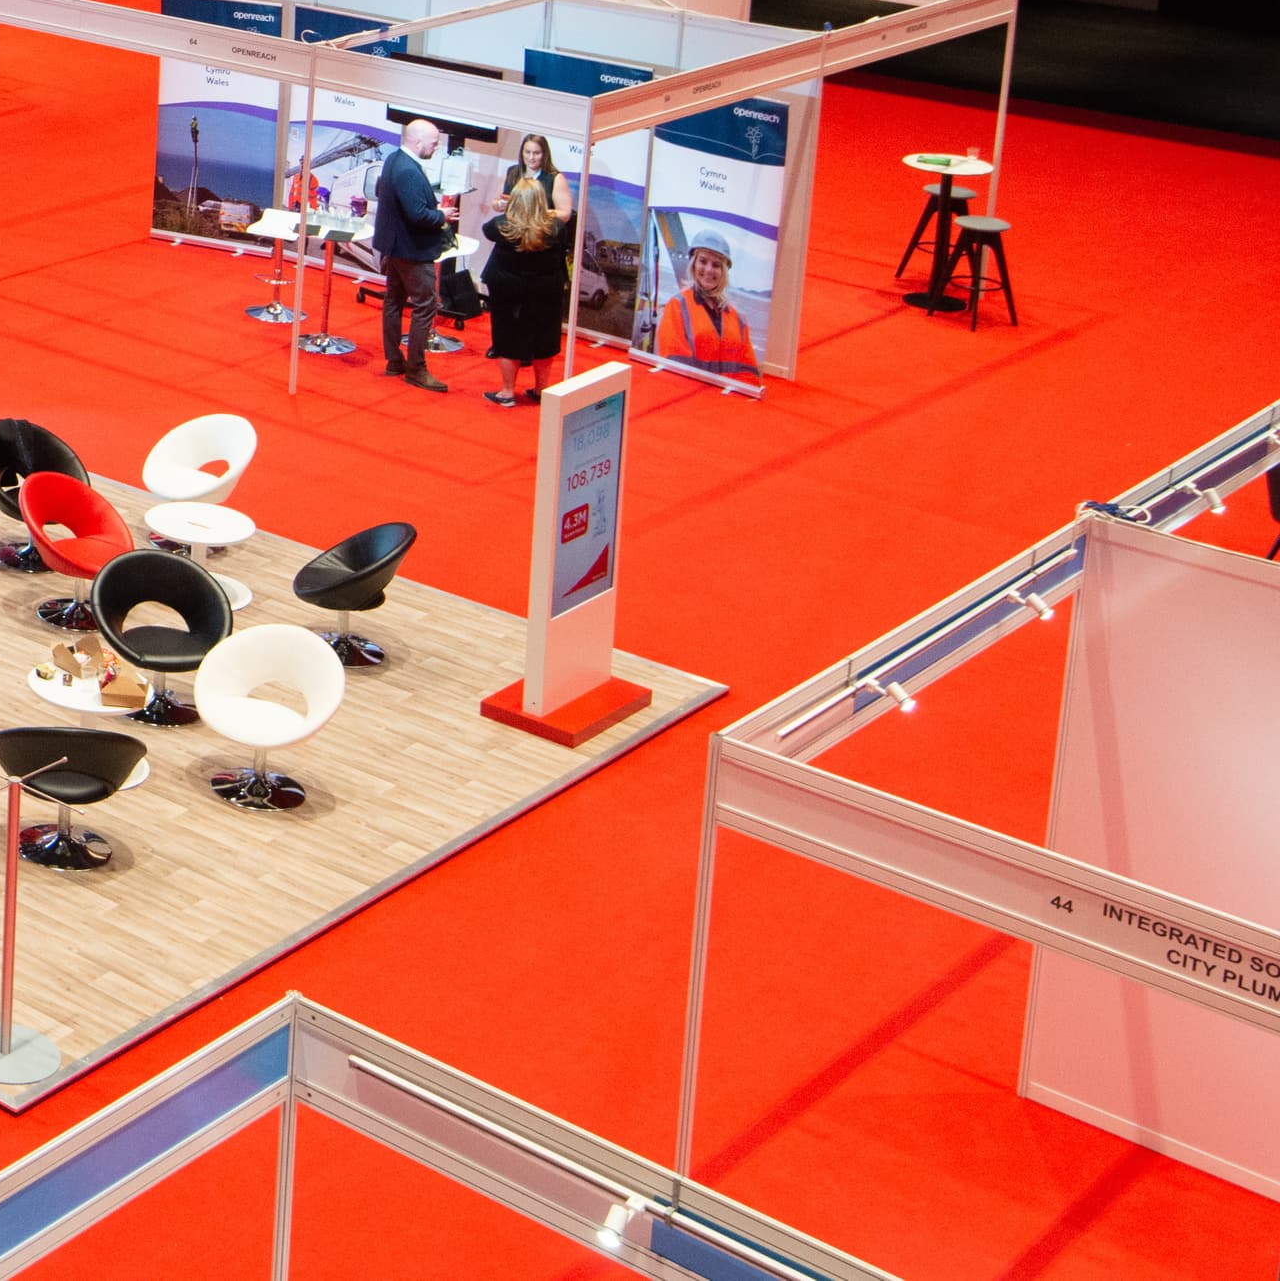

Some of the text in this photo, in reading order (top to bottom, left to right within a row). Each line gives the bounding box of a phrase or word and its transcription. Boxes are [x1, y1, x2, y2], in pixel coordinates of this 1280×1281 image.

[233, 11, 275, 23] openreach
[231, 46, 277, 62] OPENREACH
[205, 76, 229, 87] Wales
[333, 95, 356, 107] Wales
[733, 106, 780, 124] openreach
[699, 166, 728, 181] Cymru
[699, 180, 725, 194] Wales
[566, 459, 612, 492] 108,739
[1050, 896, 1243, 965] 44 INTEGRATED
[1166, 949, 1217, 978] CITY
